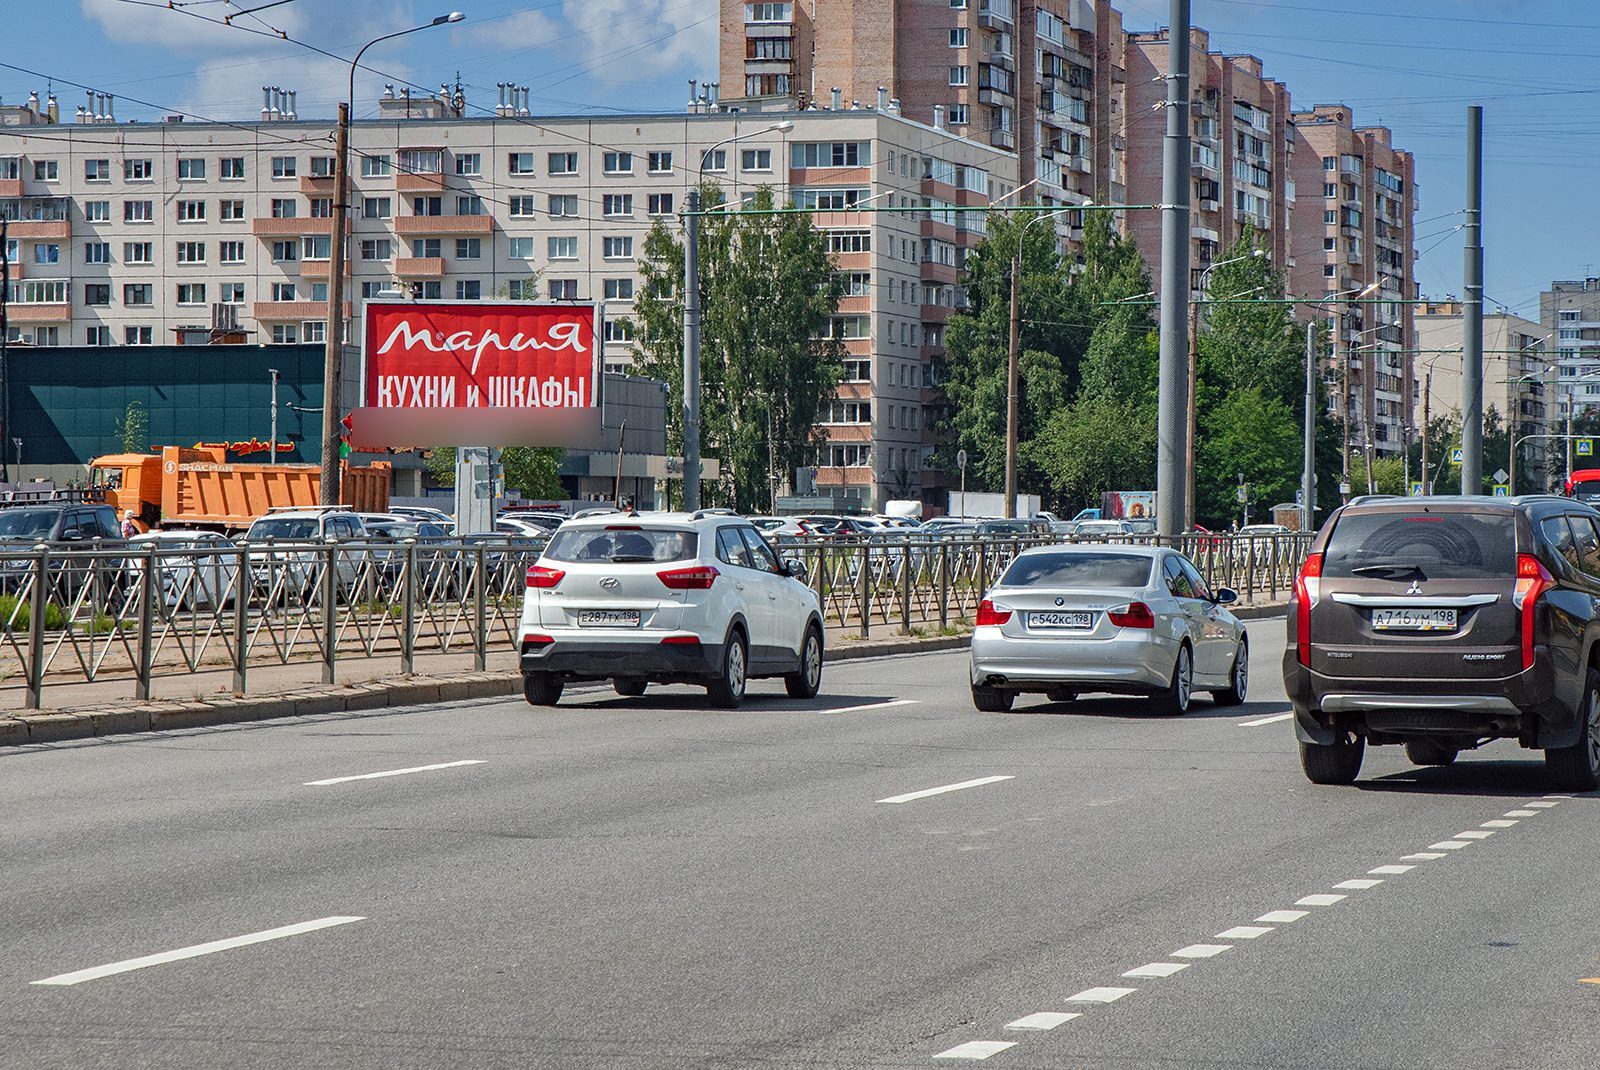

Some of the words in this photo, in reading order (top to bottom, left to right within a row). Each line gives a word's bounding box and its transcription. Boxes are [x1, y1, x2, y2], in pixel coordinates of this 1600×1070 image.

[377, 320, 588, 375] Мария
[377, 375, 456, 407] КУХНИ
[466, 385, 480, 407] и
[488, 376, 585, 407] ШКАФЫ
[179, 463, 234, 472] SHACMAN
